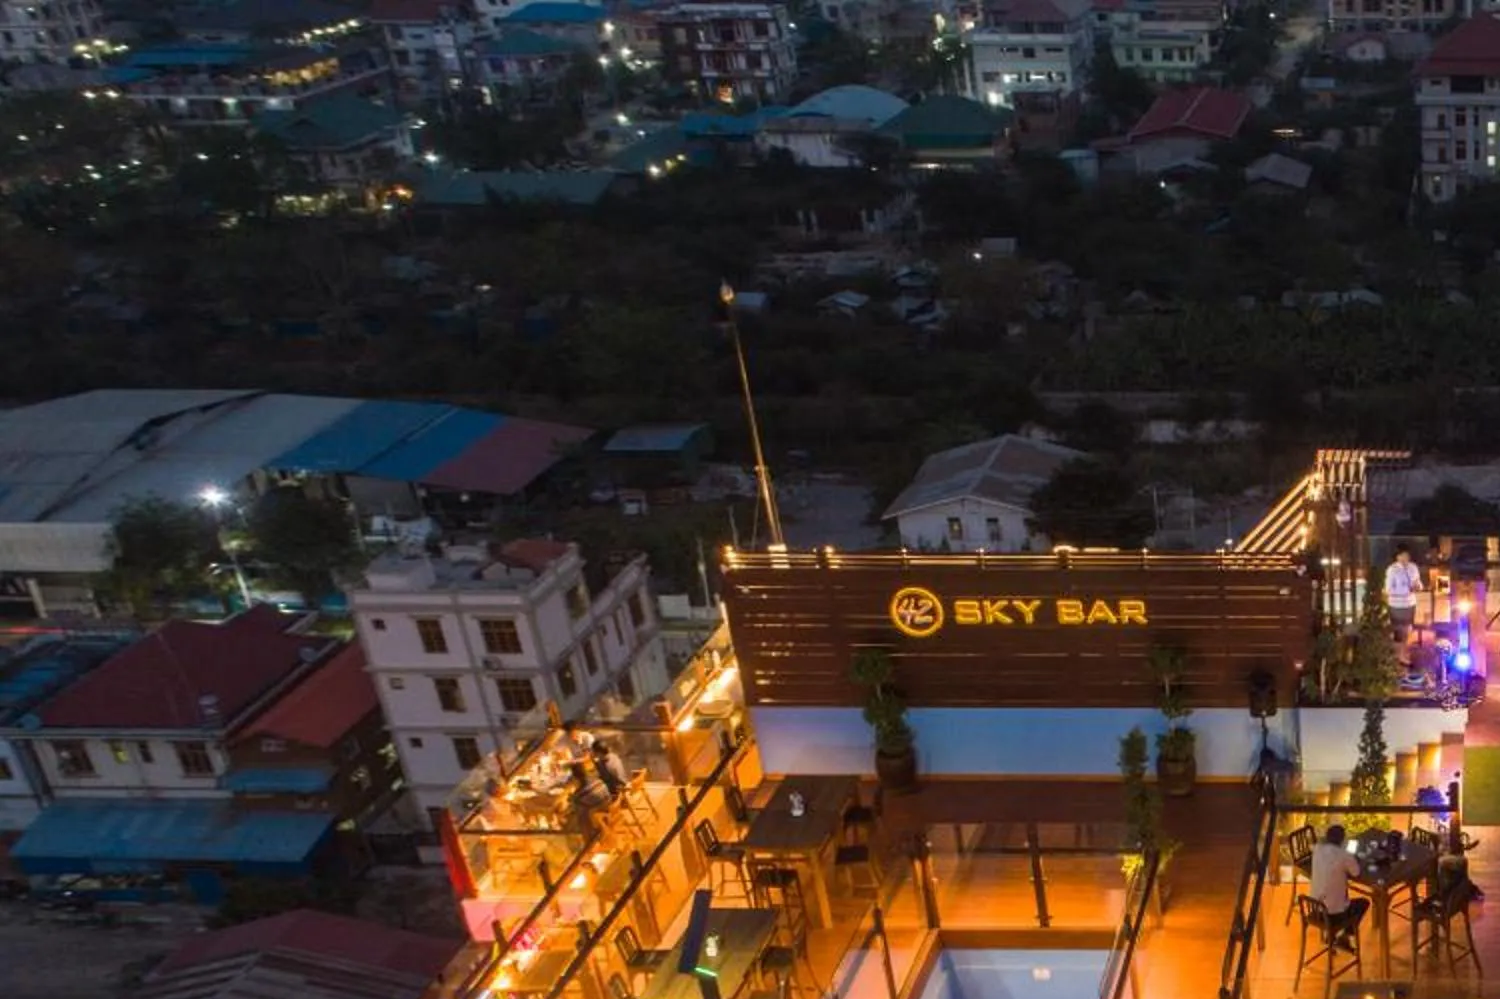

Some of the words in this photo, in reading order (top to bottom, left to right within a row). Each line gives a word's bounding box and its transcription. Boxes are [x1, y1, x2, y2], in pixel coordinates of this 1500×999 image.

[897, 597, 933, 625] 42
[953, 599, 1041, 625] SKY
[1055, 599, 1149, 625] BAR
